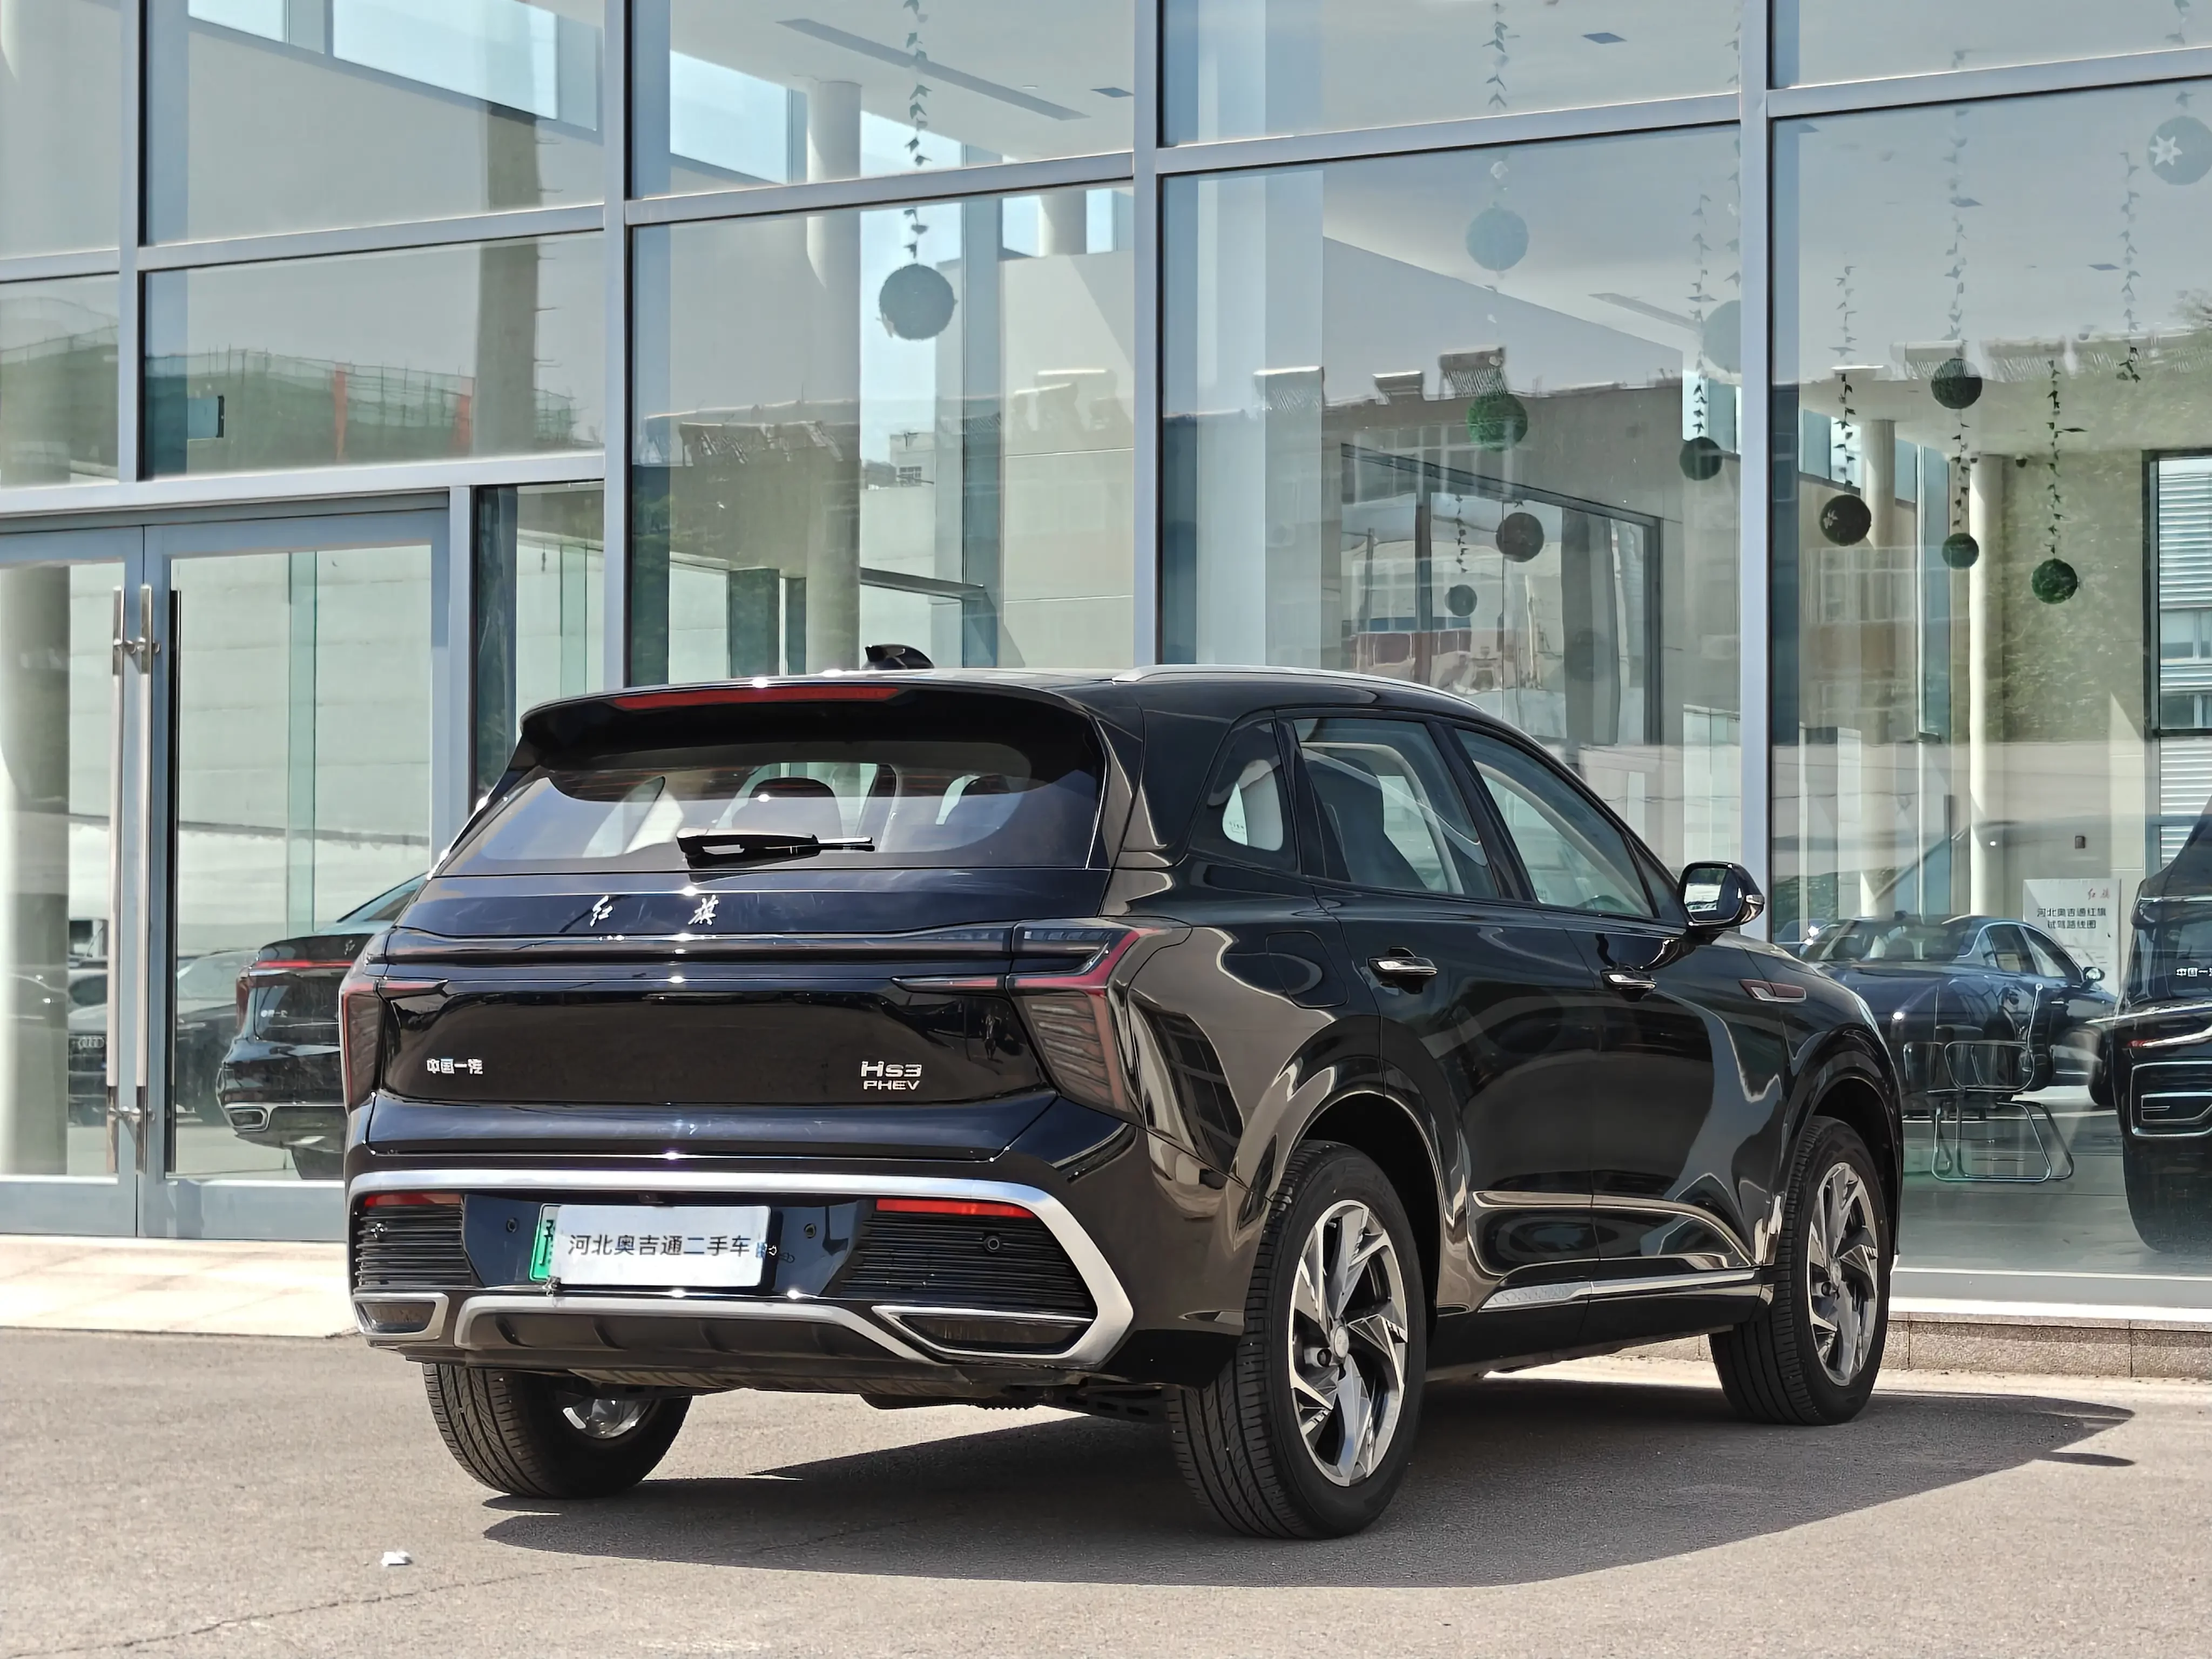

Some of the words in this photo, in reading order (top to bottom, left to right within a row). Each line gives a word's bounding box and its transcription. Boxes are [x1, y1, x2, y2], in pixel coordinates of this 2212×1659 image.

[590, 894, 719, 927] 红旗
[2037, 908, 2106, 917] 河北奥吉通红旗
[2047, 920, 2096, 929] 试驾路线图
[426, 1058, 483, 1074] 中国一汽
[863, 1080, 920, 1090] PHEV
[568, 1235, 751, 1257] 河北奥吉通二手车
